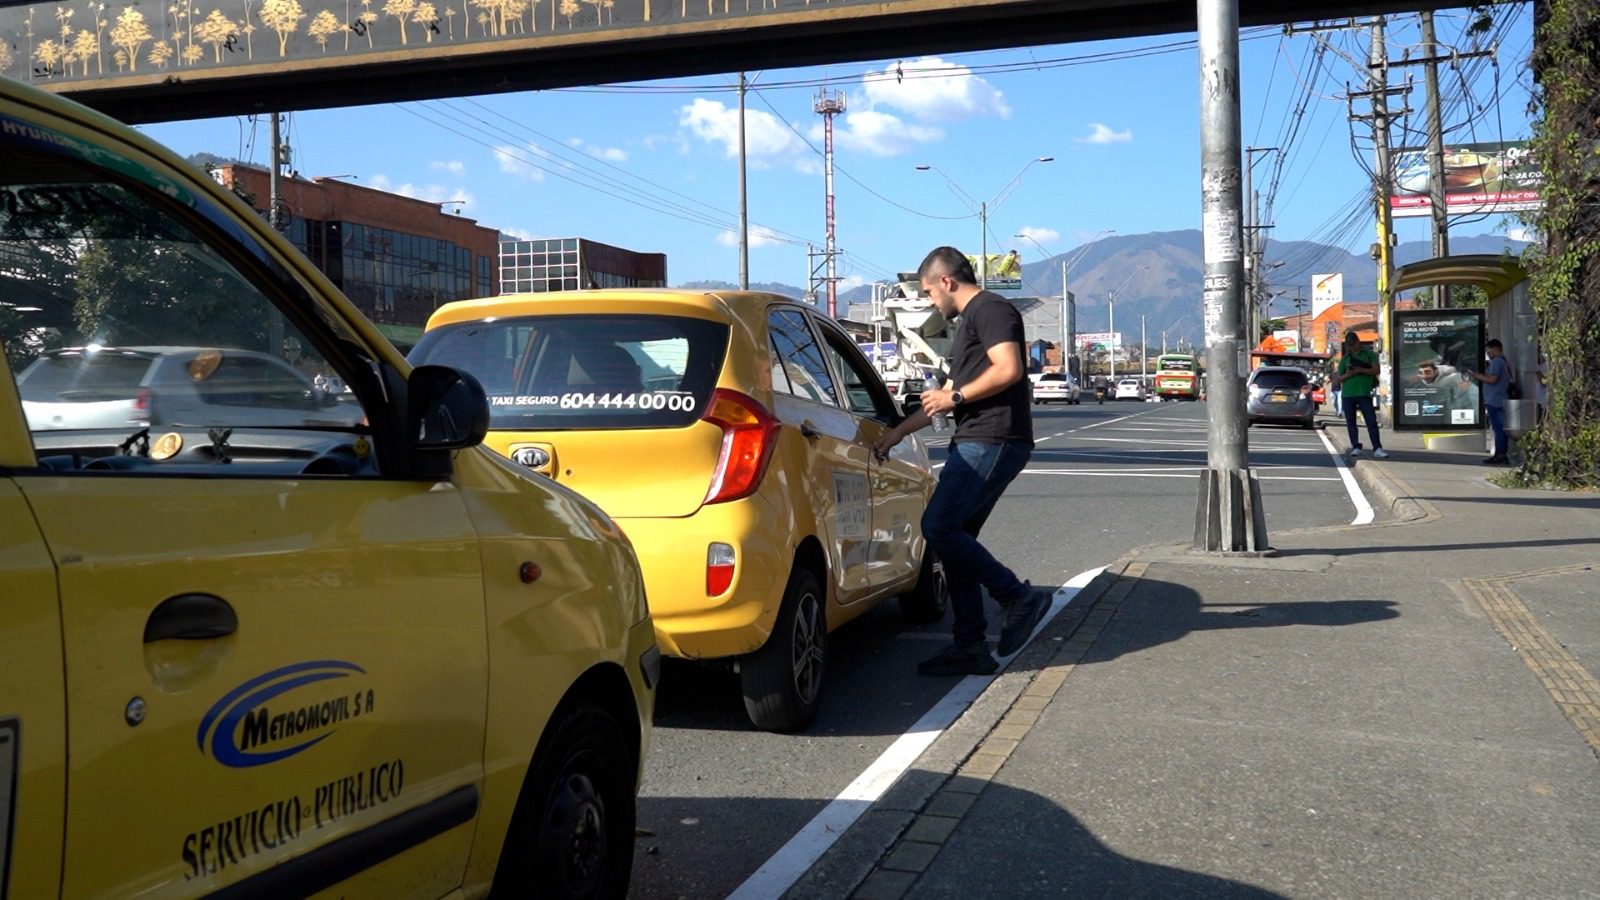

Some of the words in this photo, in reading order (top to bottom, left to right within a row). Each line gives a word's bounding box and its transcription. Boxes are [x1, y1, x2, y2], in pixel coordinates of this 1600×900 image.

[491, 396, 514, 406] TAXI
[514, 395, 559, 406] SEGURO
[560, 393, 596, 409] 604
[598, 393, 637, 409] 444
[518, 452, 543, 465] KIA
[241, 696, 350, 750] METROMOVIL
[353, 692, 362, 717] S
[365, 689, 375, 713] A
[182, 796, 302, 881] SERVICIO
[314, 758, 404, 829] PUBLICO
